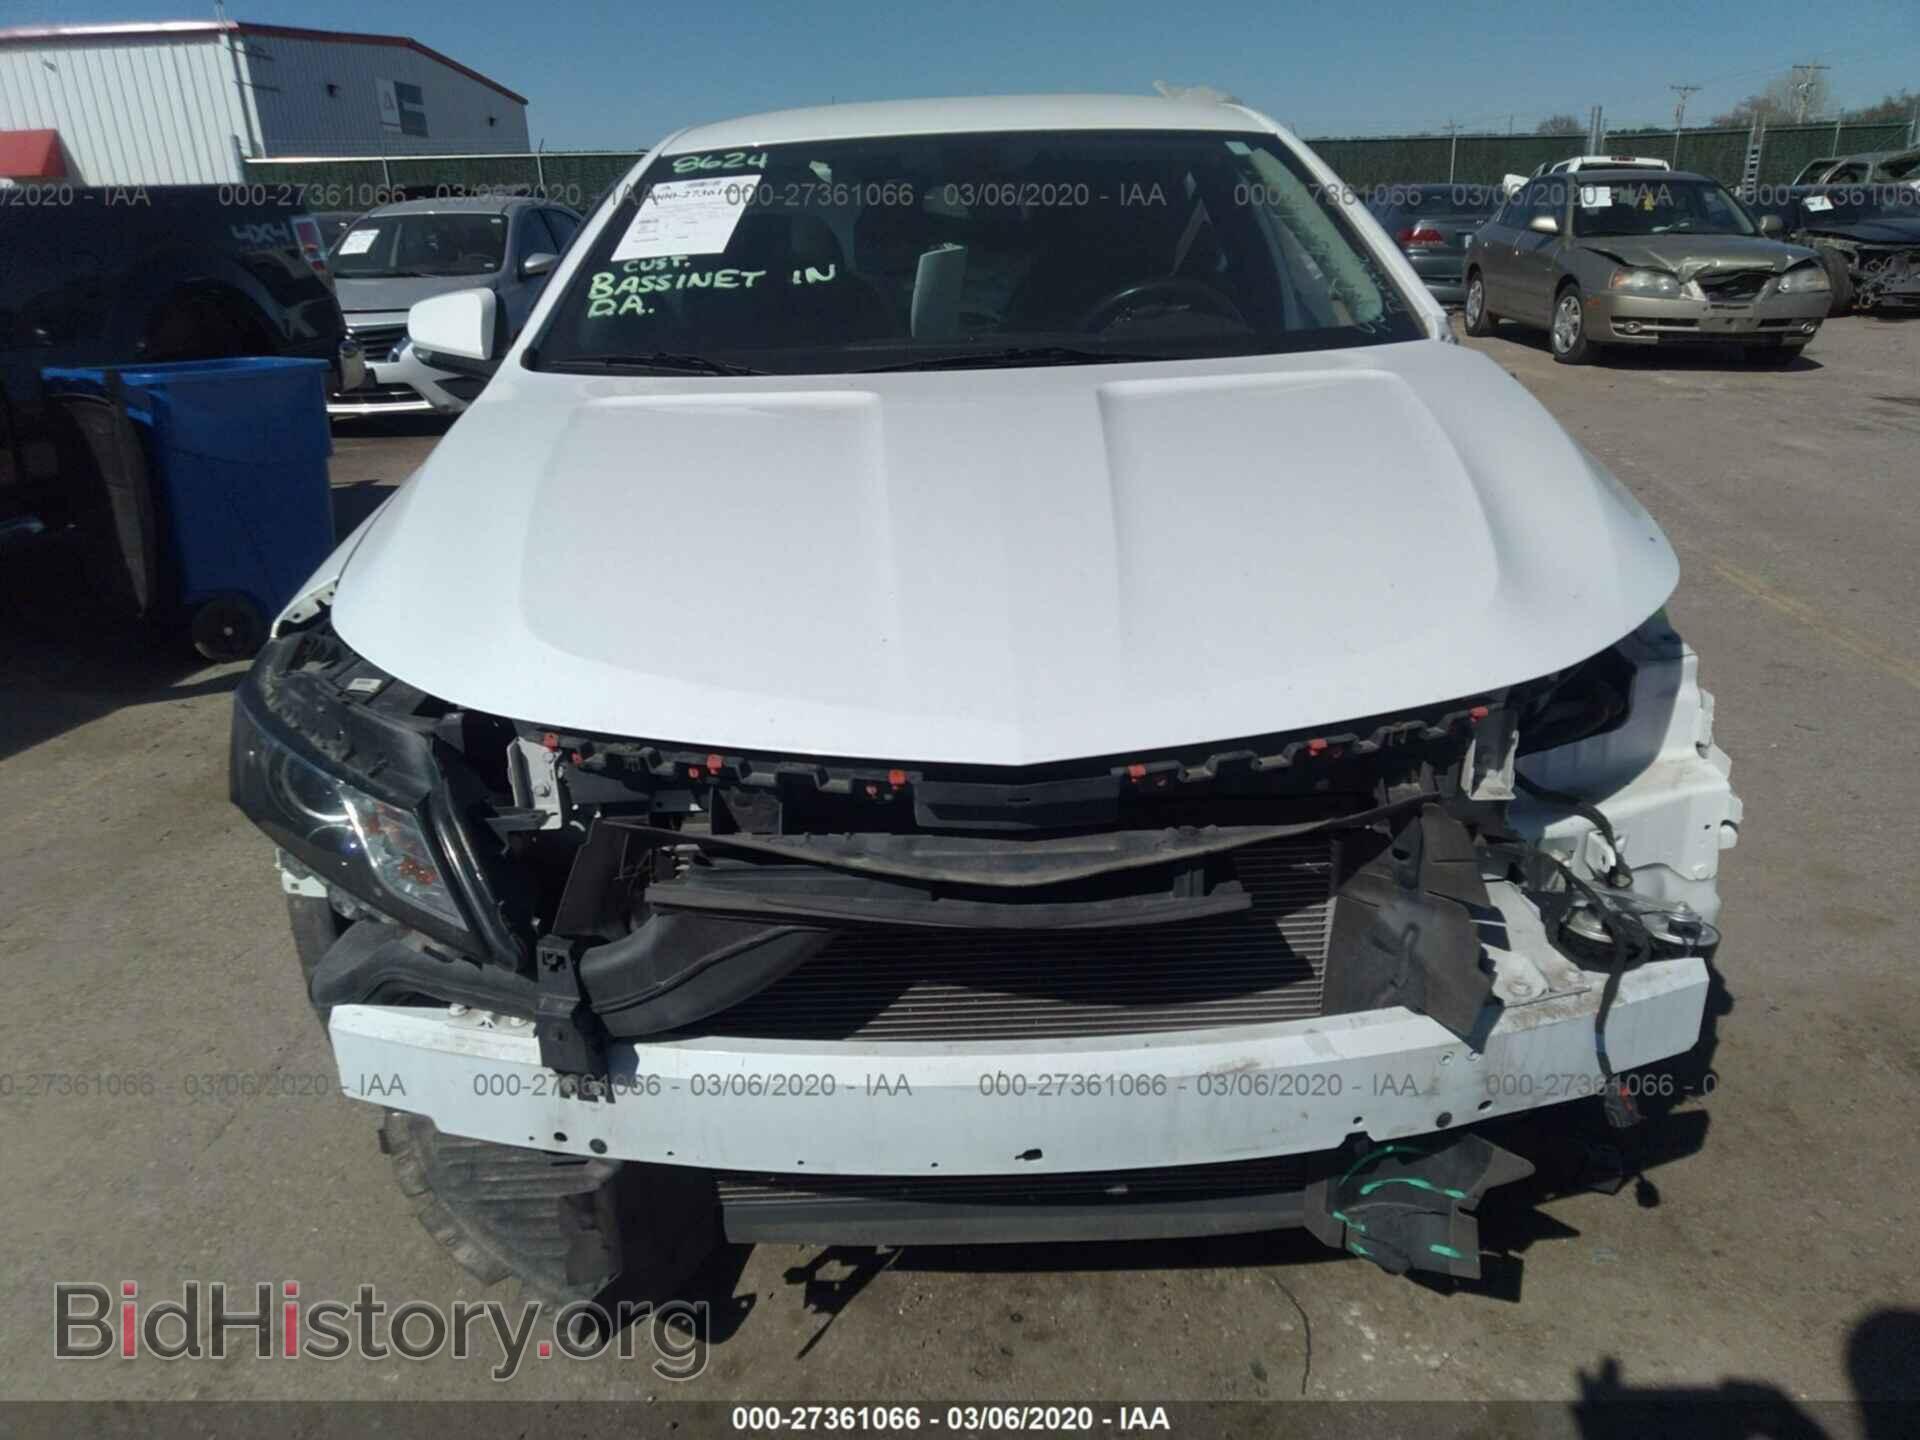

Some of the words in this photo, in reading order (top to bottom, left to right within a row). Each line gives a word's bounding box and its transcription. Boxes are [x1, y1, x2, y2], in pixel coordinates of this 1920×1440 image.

[672, 152, 768, 174] 8624
[623, 256, 691, 272] CUST.
[588, 269, 767, 300] BASSINET
[792, 264, 836, 285] IN
